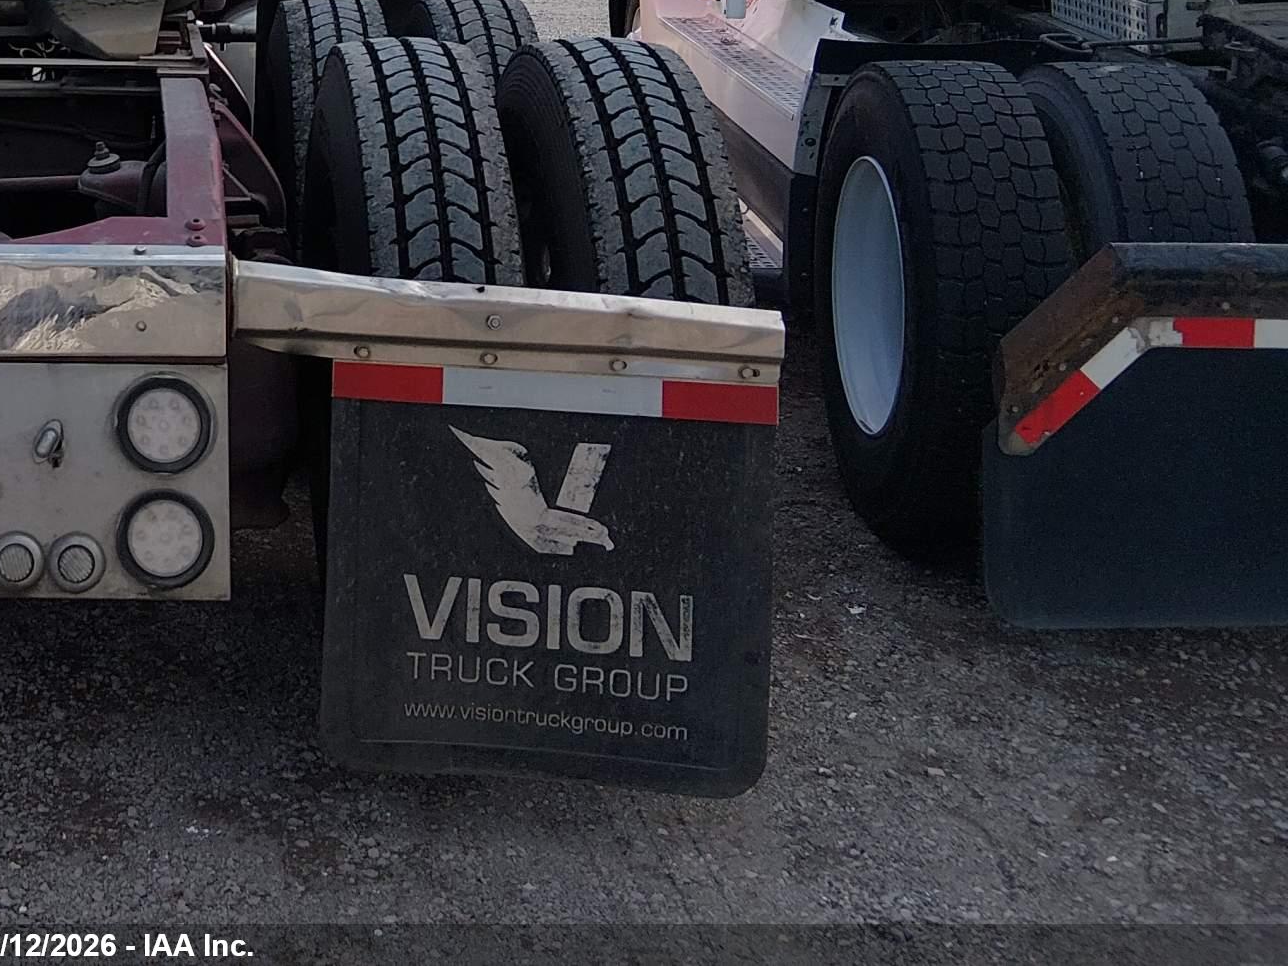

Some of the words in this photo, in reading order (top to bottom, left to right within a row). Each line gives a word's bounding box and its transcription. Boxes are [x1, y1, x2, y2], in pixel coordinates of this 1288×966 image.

[403, 574, 693, 662] VISION
[406, 651, 534, 688] TRUCK
[554, 664, 688, 701] GROUP
[404, 702, 688, 741] www.visiontruckgroup.com
